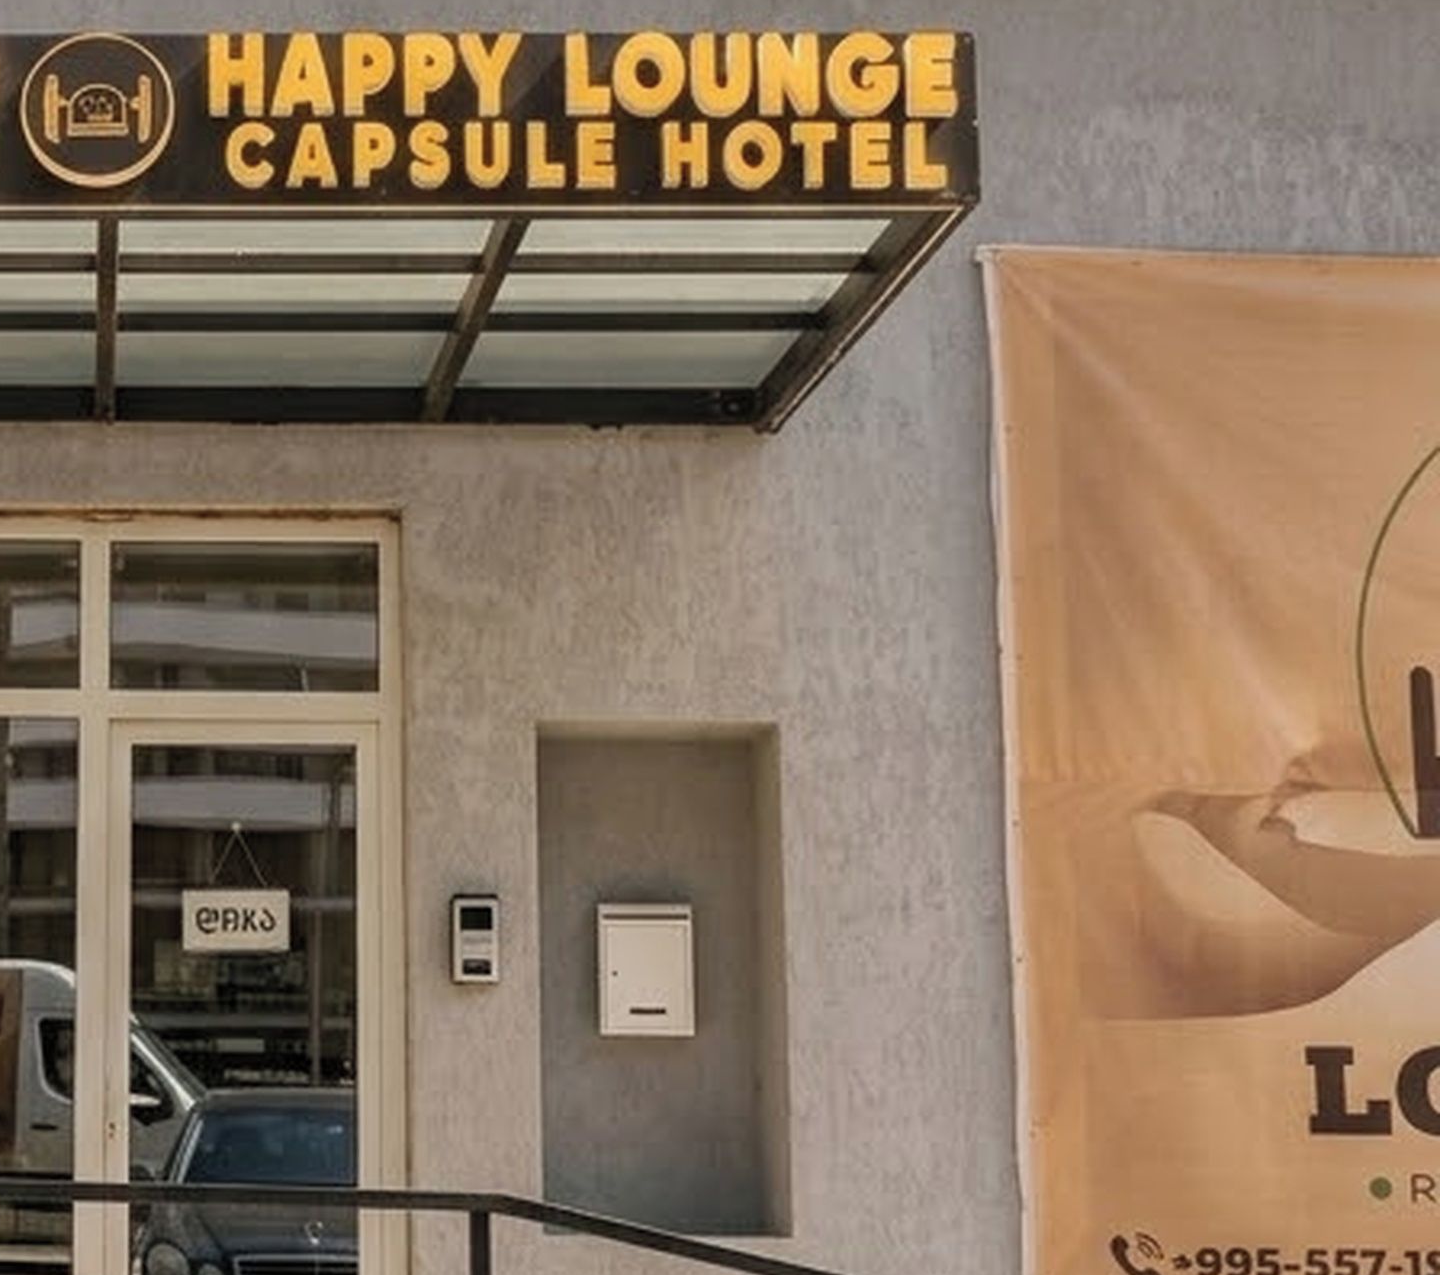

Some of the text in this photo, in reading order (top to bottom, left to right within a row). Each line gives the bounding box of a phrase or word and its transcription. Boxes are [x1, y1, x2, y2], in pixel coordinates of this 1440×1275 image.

[207, 31, 960, 118] HAPPY LOUNGE
[224, 122, 948, 190] CAPSULE HOTEL
